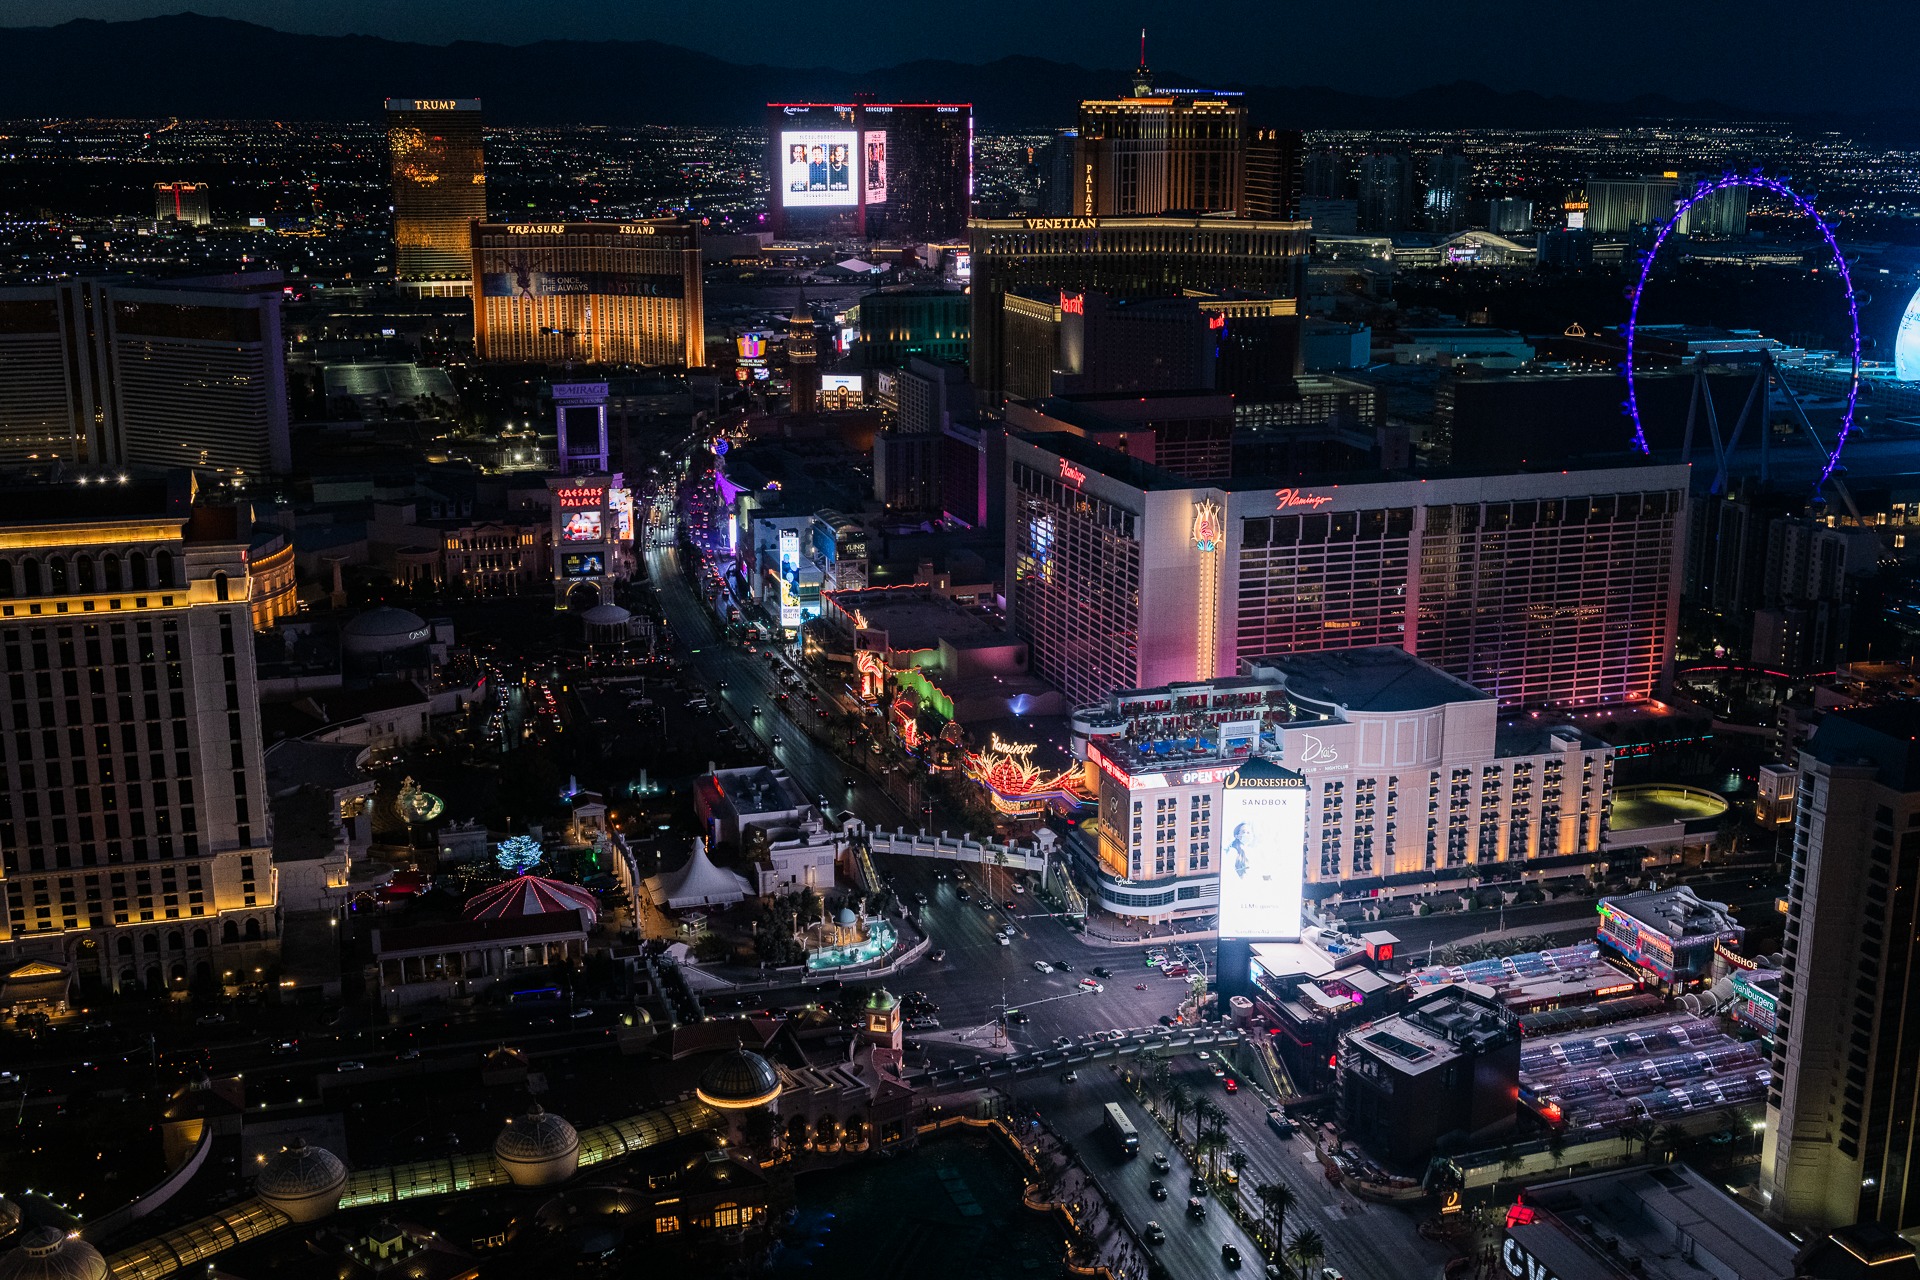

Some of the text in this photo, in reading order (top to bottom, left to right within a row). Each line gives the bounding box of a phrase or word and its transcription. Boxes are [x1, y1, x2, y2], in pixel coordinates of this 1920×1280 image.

[414, 100, 456, 110] TRUMP
[507, 225, 655, 235] TREASURE ISLAND
[1026, 218, 1097, 230] VENETIAN
[541, 277, 556, 285] THE
[541, 284, 589, 292] THE ALWAYS
[568, 385, 606, 394] MIRAGE
[1059, 458, 1086, 488] Flamingo
[557, 487, 603, 498] CAESARS
[560, 498, 601, 507] PALACE
[1275, 488, 1333, 510] Flamingo
[992, 732, 1038, 760] Flamingo
[1300, 733, 1338, 764] Drai's
[1183, 770, 1213, 784] OPEN
[1239, 778, 1304, 787] HORSESHOE
[1719, 944, 1758, 970] HORSESHOE
[1732, 981, 1774, 1010] wahlburgers
[1503, 1238, 1560, 1280] CV
